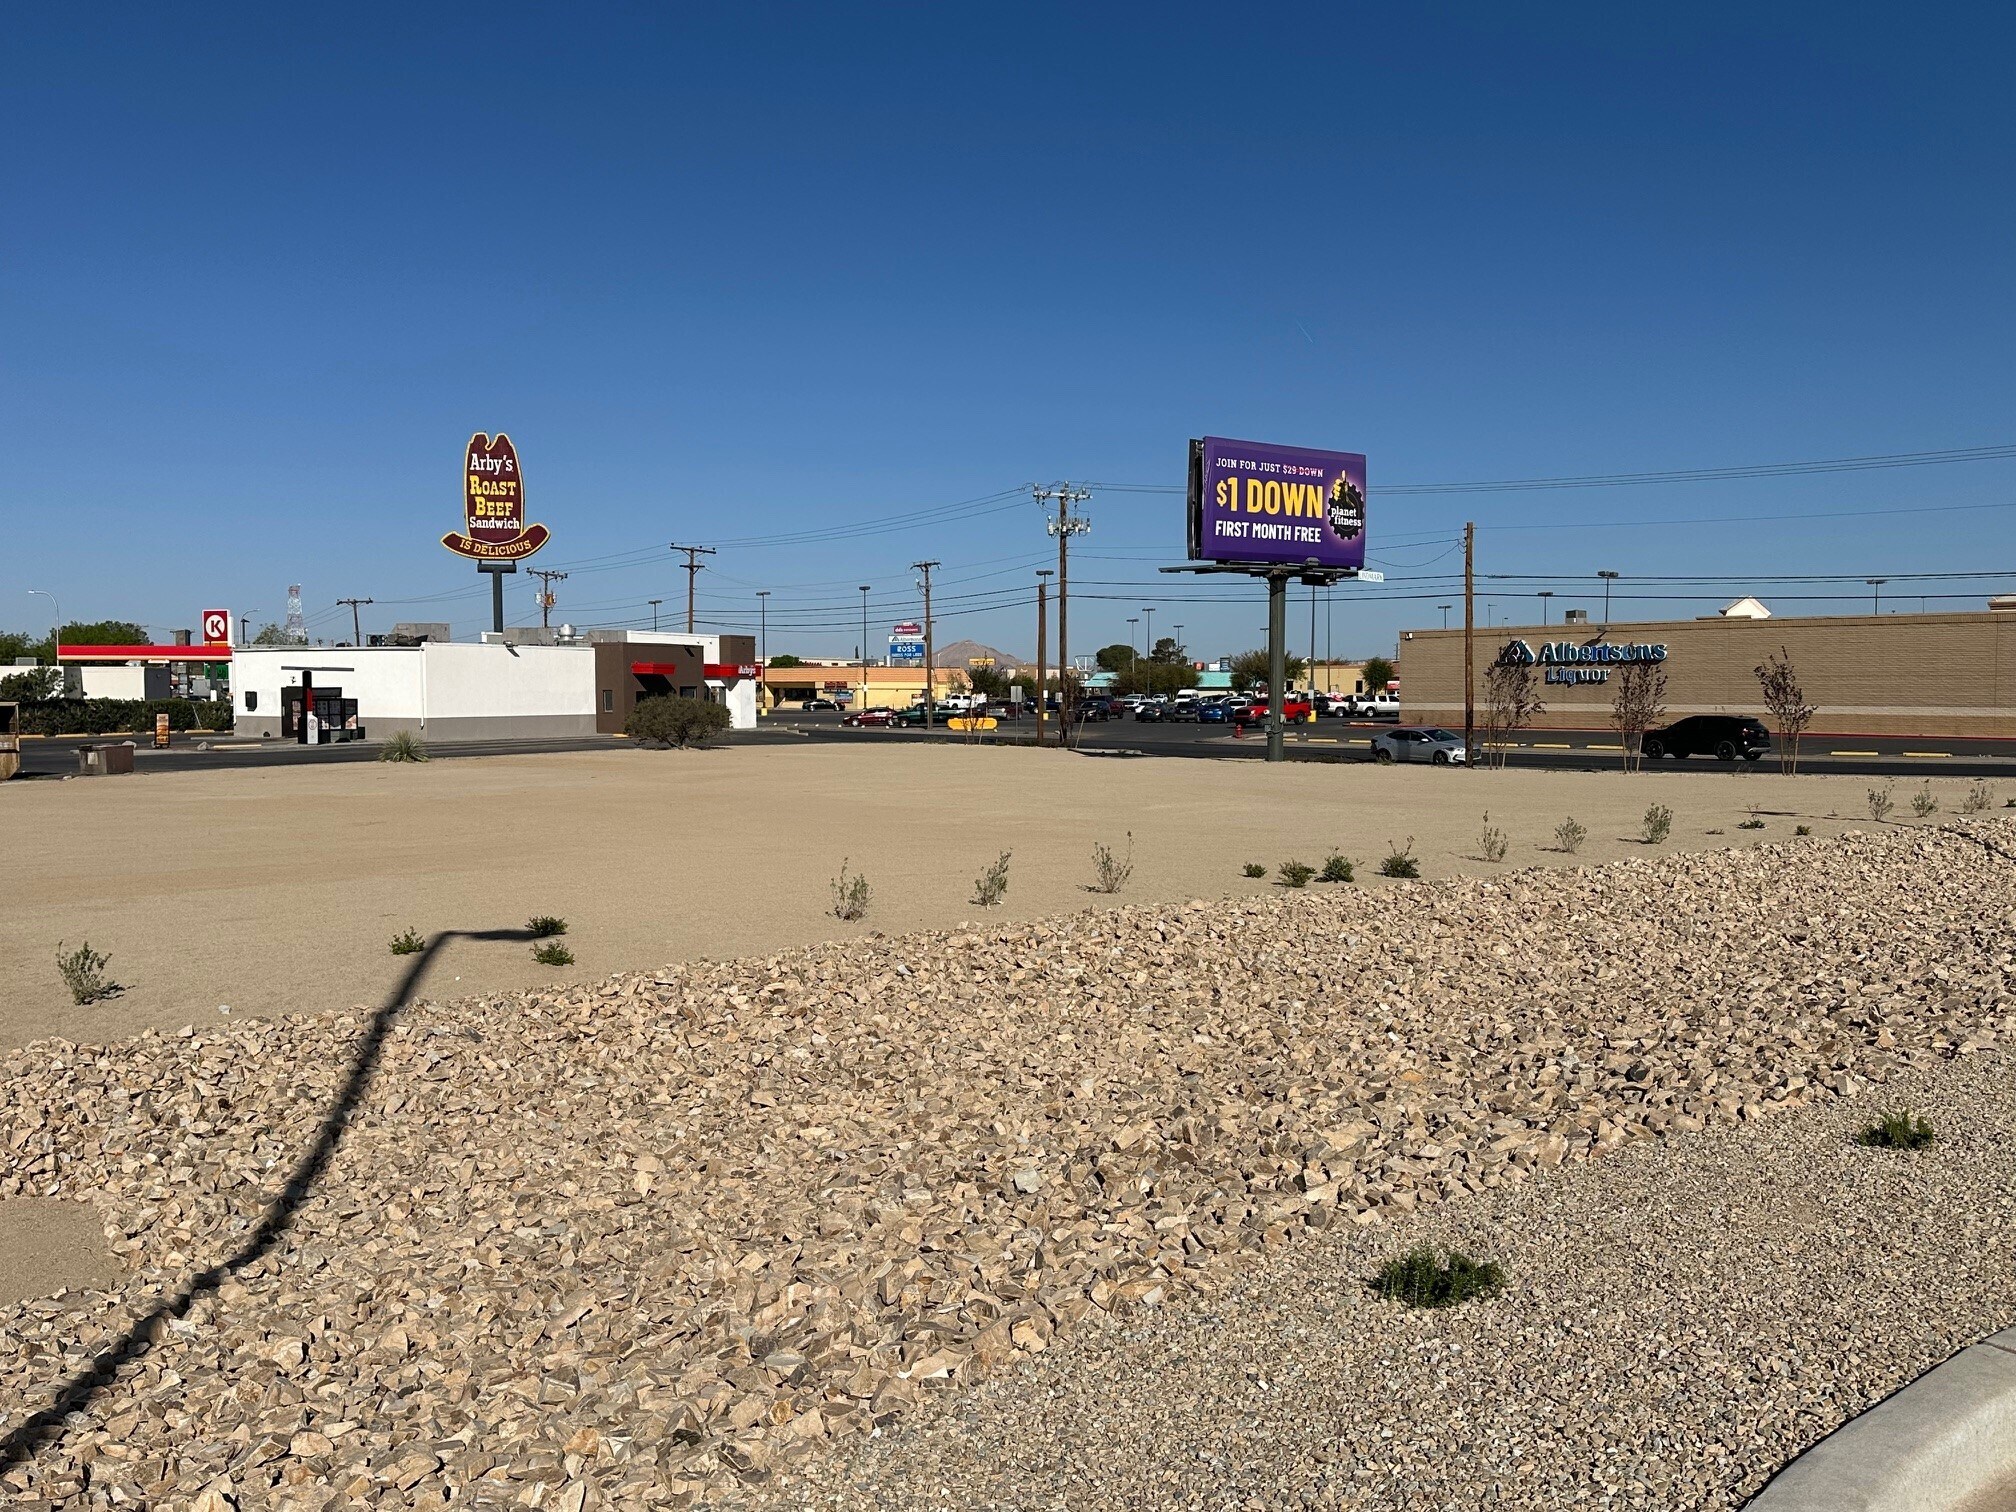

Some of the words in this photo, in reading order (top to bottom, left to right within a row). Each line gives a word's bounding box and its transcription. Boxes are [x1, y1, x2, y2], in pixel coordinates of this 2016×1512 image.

[469, 453, 513, 475] Arby's
[1216, 457, 1237, 469] JOIN
[1239, 460, 1257, 471] FOR
[1258, 462, 1281, 474] JUST
[1282, 464, 1297, 475] $29
[1299, 466, 1324, 478] DOWN
[469, 475, 517, 496] ROAST
[475, 496, 514, 516] BEEF
[1216, 476, 1238, 512] $1
[1246, 478, 1324, 519] DOWN
[1330, 507, 1357, 518] planet
[1333, 516, 1362, 527] fitness
[469, 516, 520, 530] Sandwich
[1215, 520, 1250, 538] FIRST
[1252, 523, 1292, 541] MONTH
[1294, 526, 1322, 543] FREE
[459, 539, 472, 550] IS
[473, 539, 532, 556] DELICIOUS
[210, 620, 222, 634] K
[1540, 641, 1668, 663] Albertsons
[1547, 665, 1611, 685] Liquor
